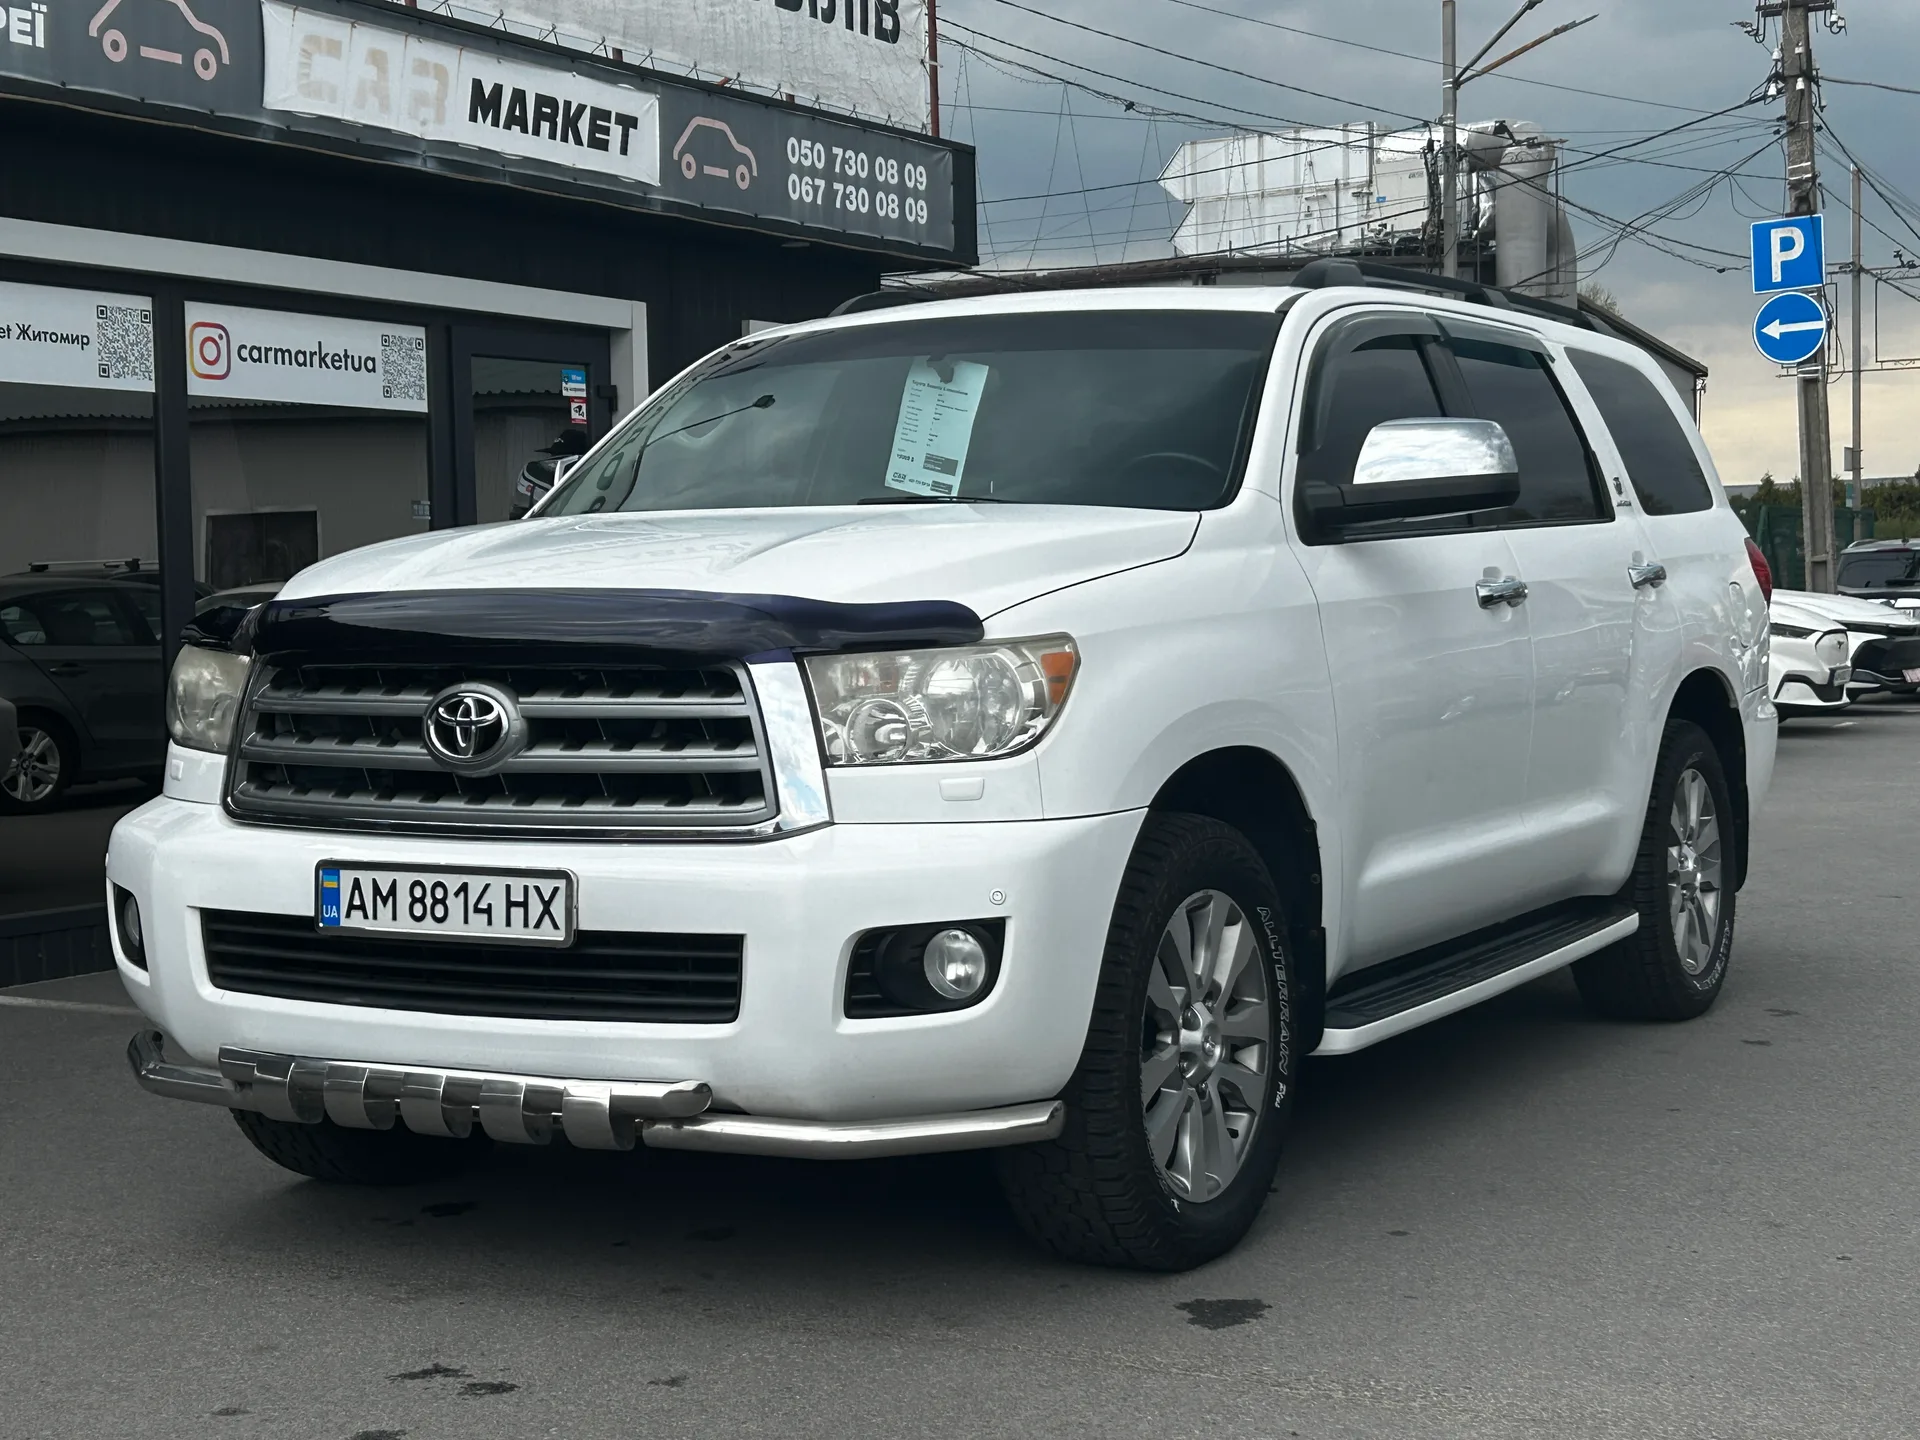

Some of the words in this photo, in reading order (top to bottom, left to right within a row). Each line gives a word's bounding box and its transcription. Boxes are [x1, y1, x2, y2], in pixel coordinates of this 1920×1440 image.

[0, 2, 47, 48] ЕЇ
[468, 77, 639, 156] MARKET
[787, 136, 825, 169] 050
[832, 146, 868, 178] 730
[875, 156, 898, 184] 08
[904, 163, 927, 190] 09
[788, 173, 825, 205] 067
[833, 182, 869, 213] 730
[876, 191, 899, 219] 08
[905, 197, 928, 225] 09
[1770, 226, 1805, 282] P
[15, 323, 90, 350] Житомир
[237, 341, 376, 373] carmarketua
[323, 904, 338, 918] UA
[345, 877, 397, 921] AM
[409, 879, 492, 926] 8814
[505, 883, 560, 930] HX
